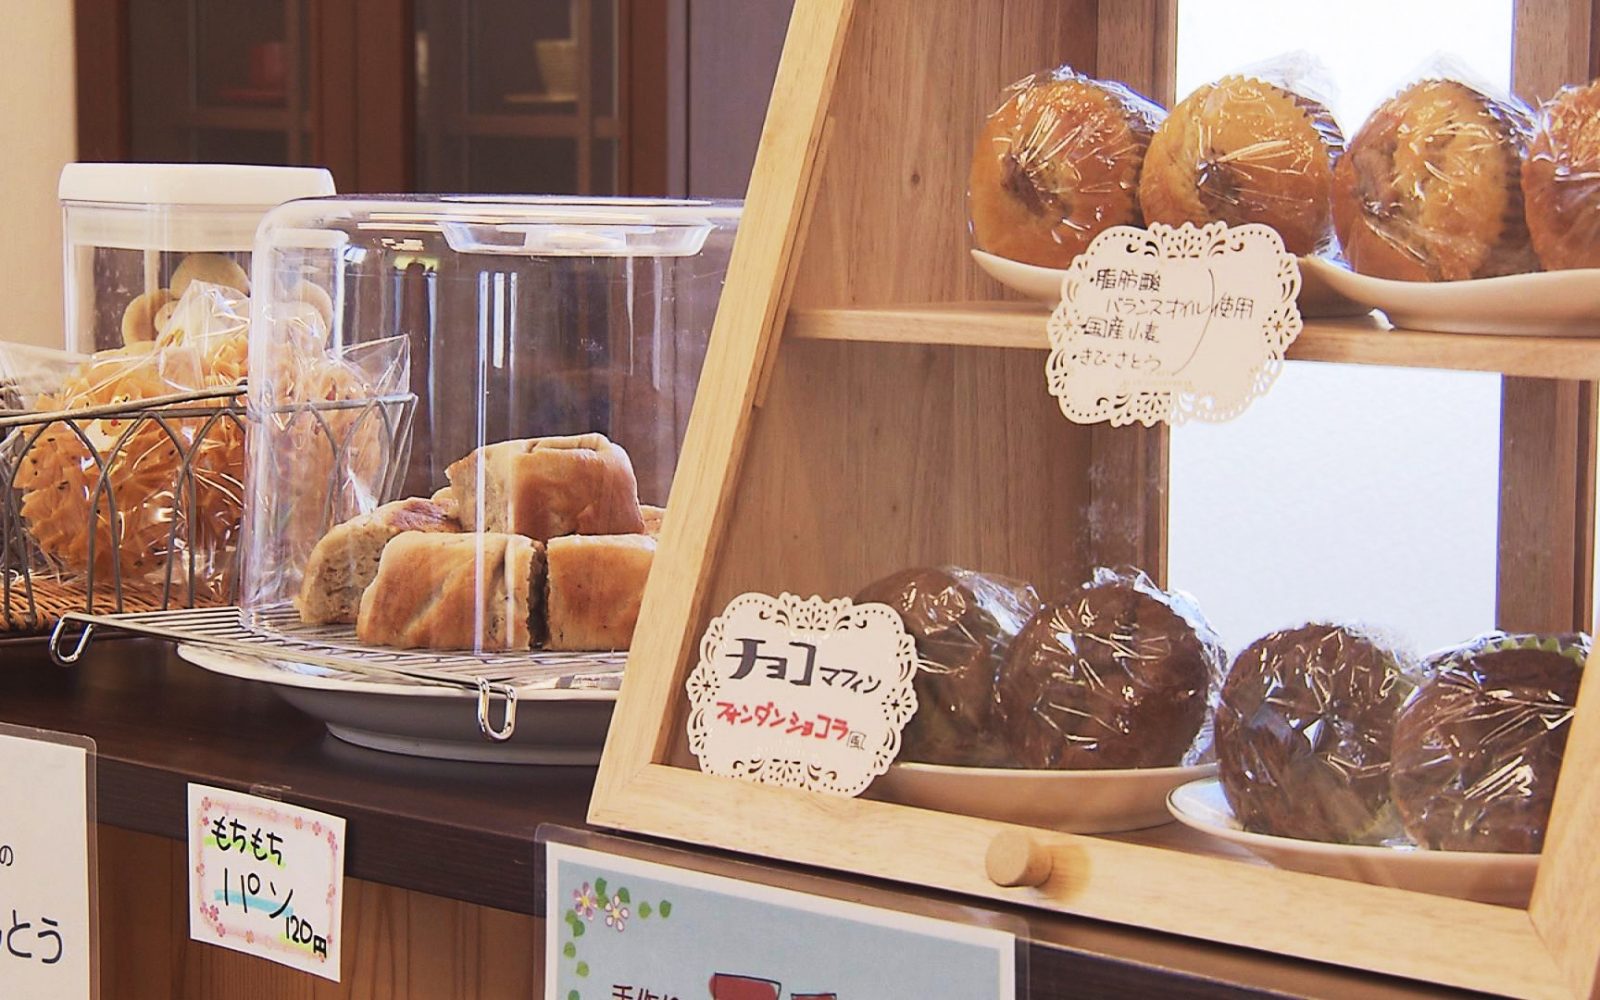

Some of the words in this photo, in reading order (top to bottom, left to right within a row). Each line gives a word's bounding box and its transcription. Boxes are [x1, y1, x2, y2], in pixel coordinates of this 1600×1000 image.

[211, 815, 284, 866] もちもち
[223, 867, 294, 919] パン
[0, 908, 63, 964] とう
